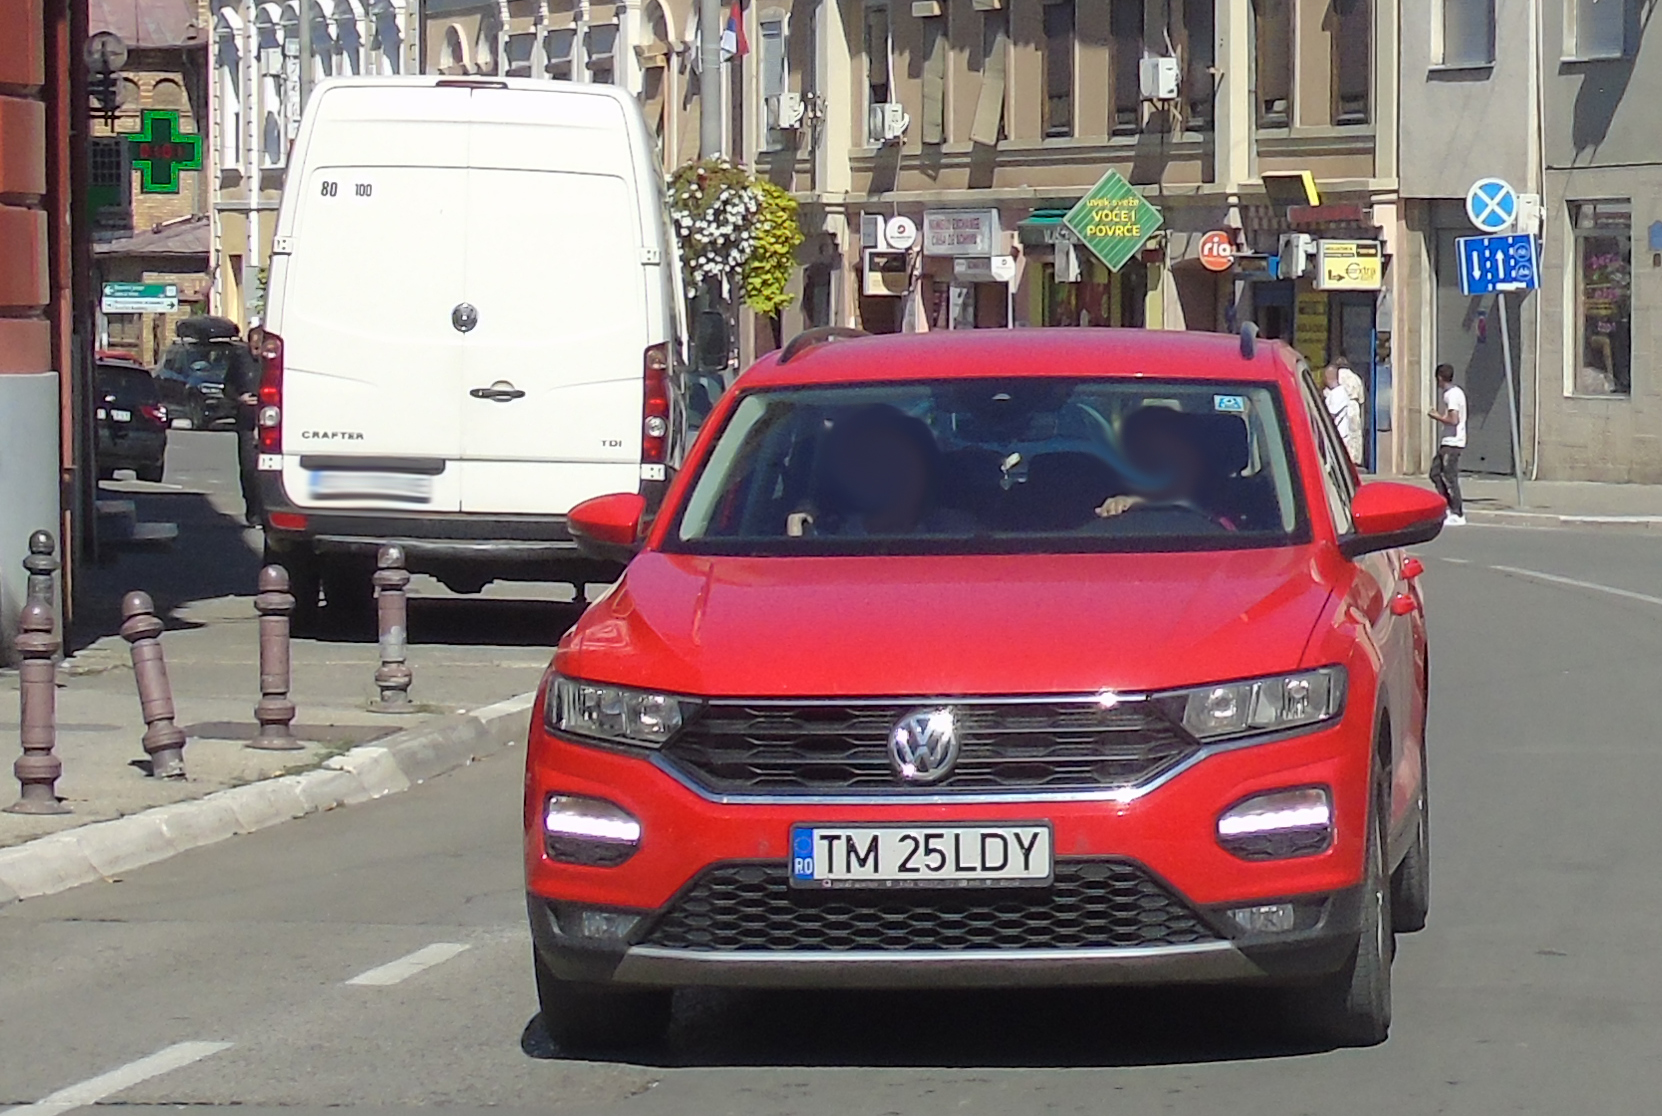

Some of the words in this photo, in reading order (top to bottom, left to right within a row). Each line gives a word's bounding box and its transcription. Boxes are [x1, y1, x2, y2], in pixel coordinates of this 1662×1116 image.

[320, 180, 338, 197] 80
[355, 183, 373, 197] 100
[1092, 207, 1129, 222] VOĆE
[1086, 222, 1141, 237] POVRĆE
[1203, 236, 1231, 257] ria
[301, 430, 364, 440] CRAFTER
[600, 439, 622, 448] TDI
[794, 857, 814, 875] RO
[818, 834, 880, 874] TM
